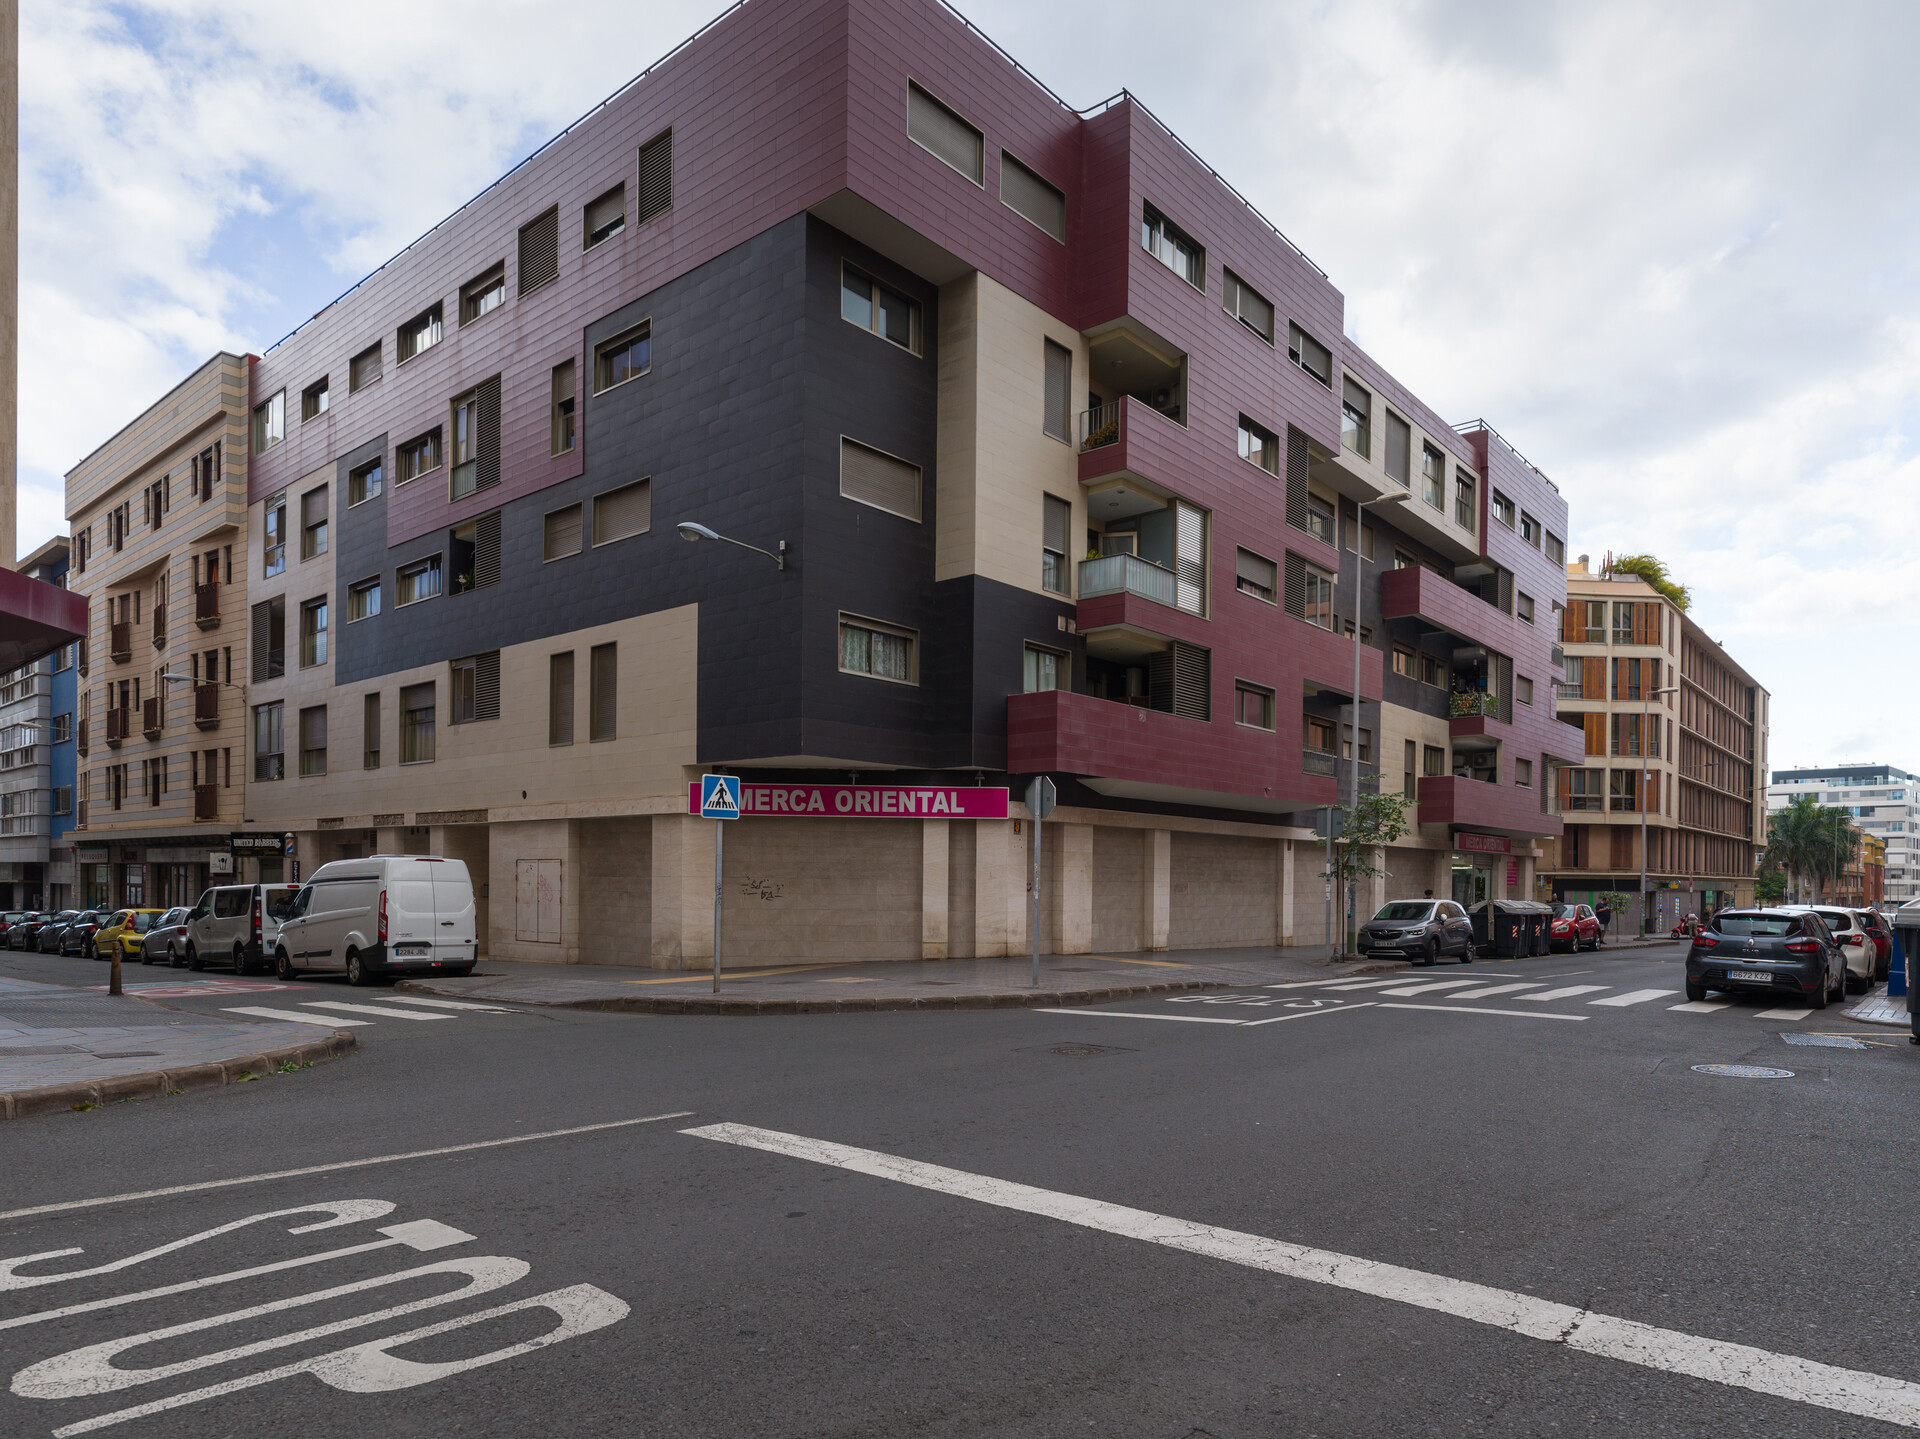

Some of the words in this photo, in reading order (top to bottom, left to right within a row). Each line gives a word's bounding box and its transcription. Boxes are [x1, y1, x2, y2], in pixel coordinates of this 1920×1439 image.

[738, 788, 825, 812] MERCA
[834, 790, 965, 814] ORIENTAL
[1465, 835, 1482, 849] MERCA
[1733, 971, 1752, 979] 6672
[1165, 994, 1345, 1008] STOP
[0, 1199, 631, 1438] STOP
